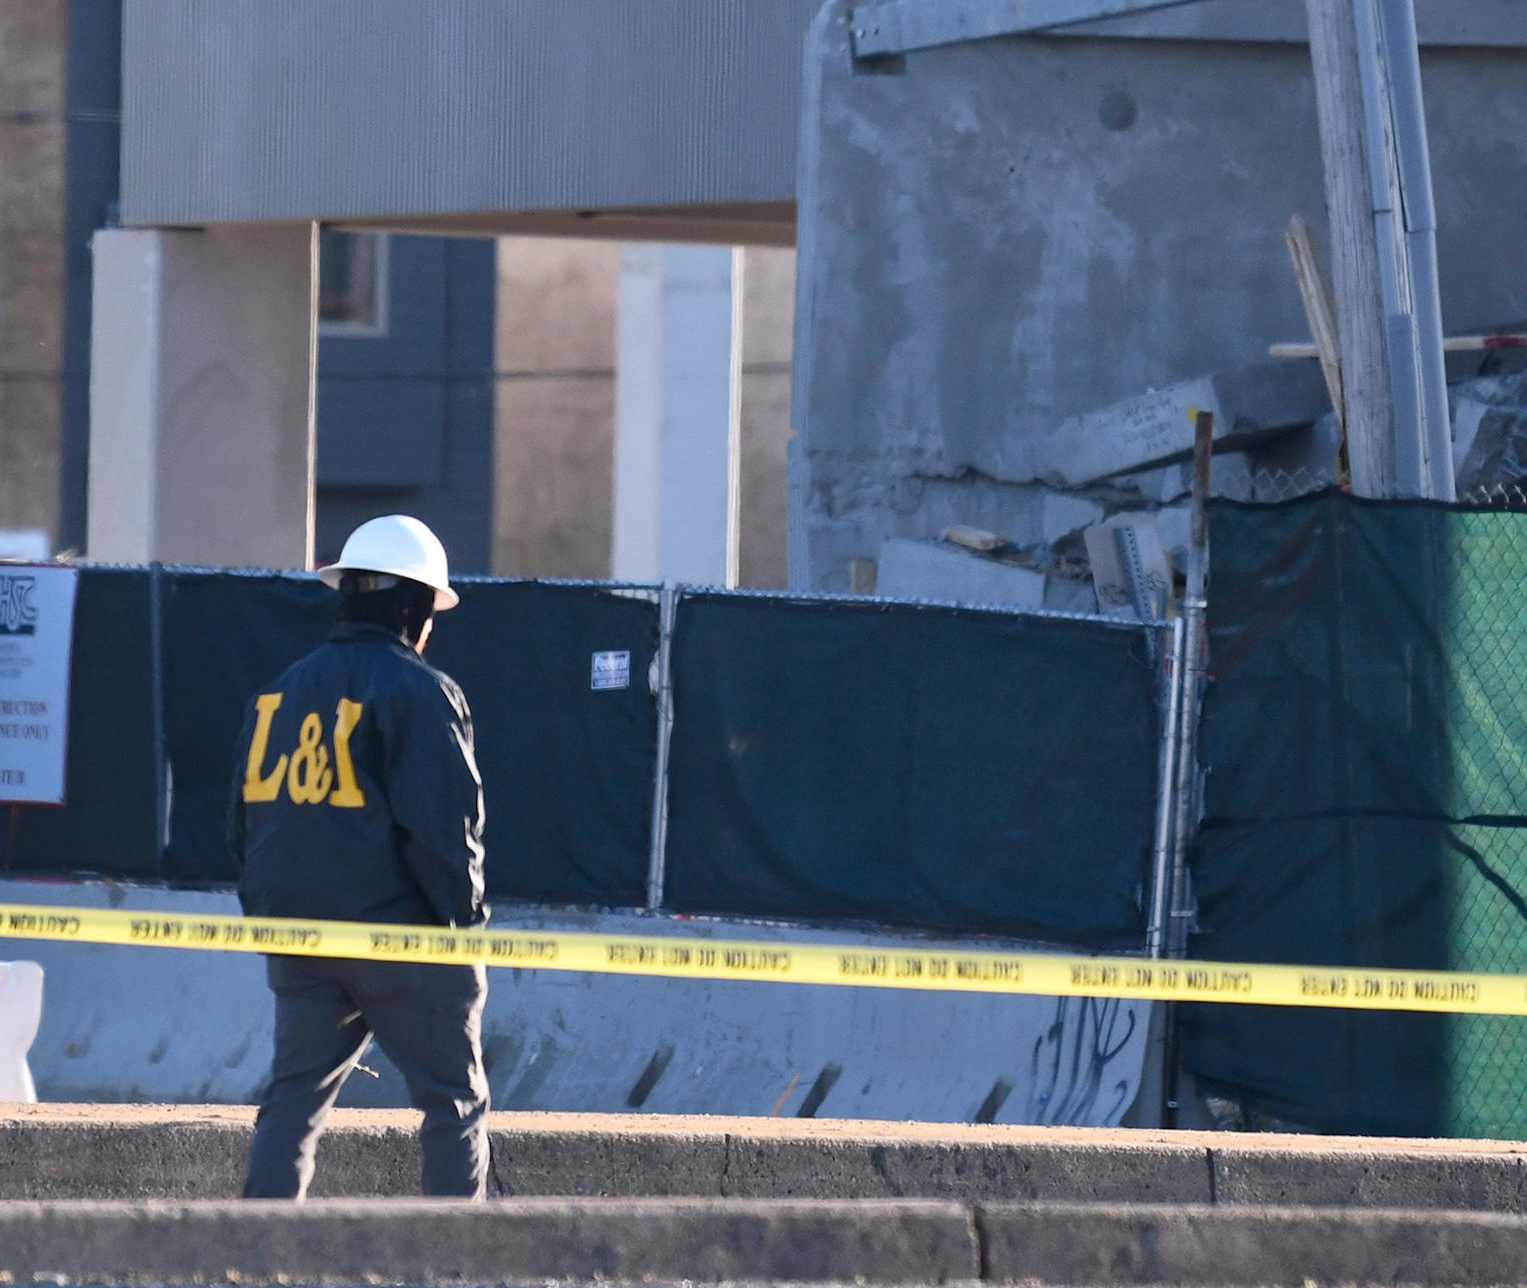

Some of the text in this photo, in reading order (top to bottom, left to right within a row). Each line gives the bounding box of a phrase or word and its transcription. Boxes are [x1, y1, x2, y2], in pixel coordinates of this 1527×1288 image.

[22, 723, 50, 740] ONLY
[242, 692, 366, 808] L&I
[9, 914, 81, 938] CAUTION
